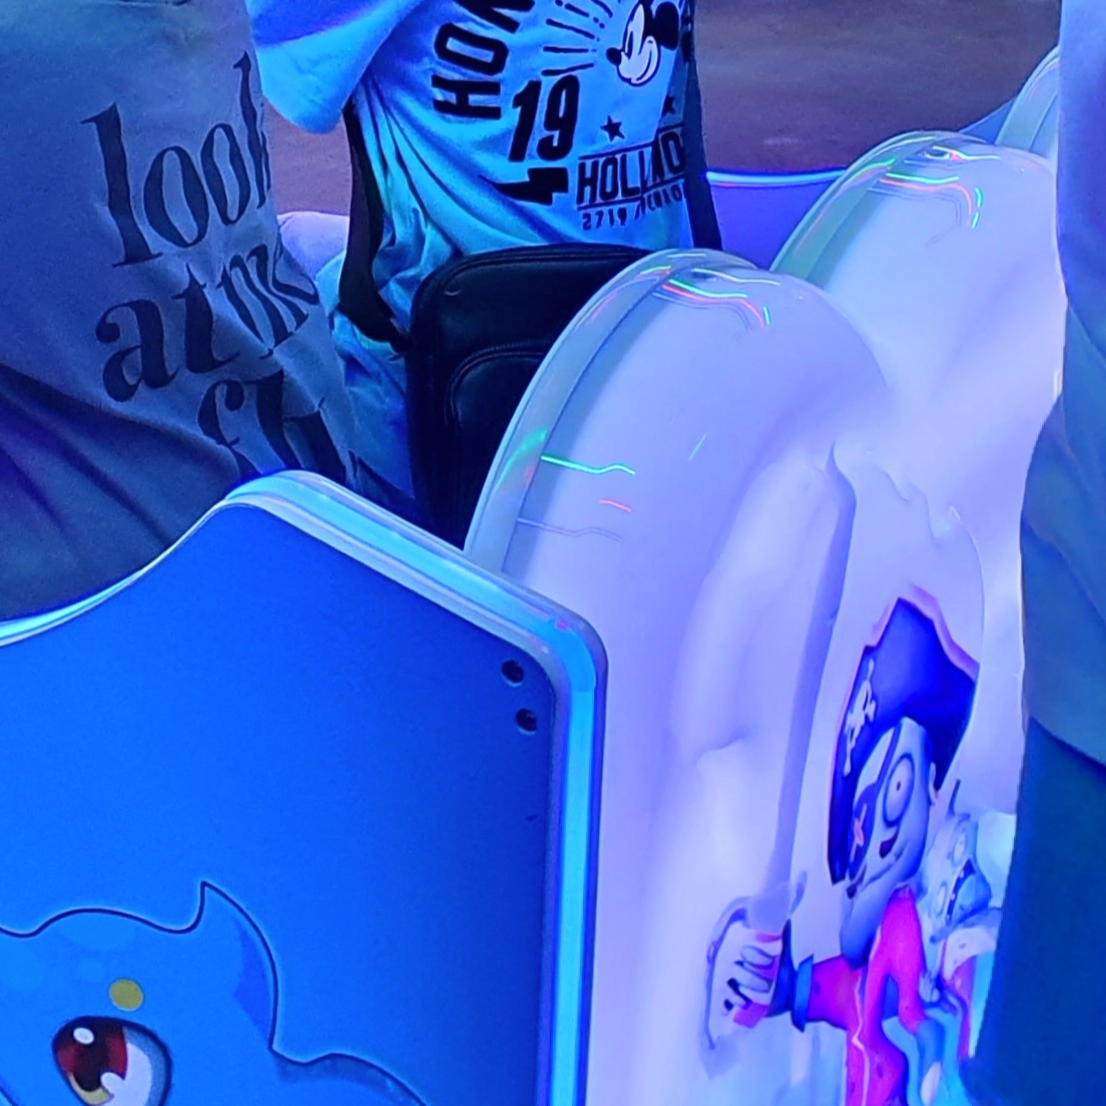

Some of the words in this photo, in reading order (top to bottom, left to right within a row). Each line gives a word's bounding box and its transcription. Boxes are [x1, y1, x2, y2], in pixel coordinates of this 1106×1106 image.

[508, 74, 580, 162] 19
[582, 206, 628, 231] 2719
[95, 263, 240, 403] at
